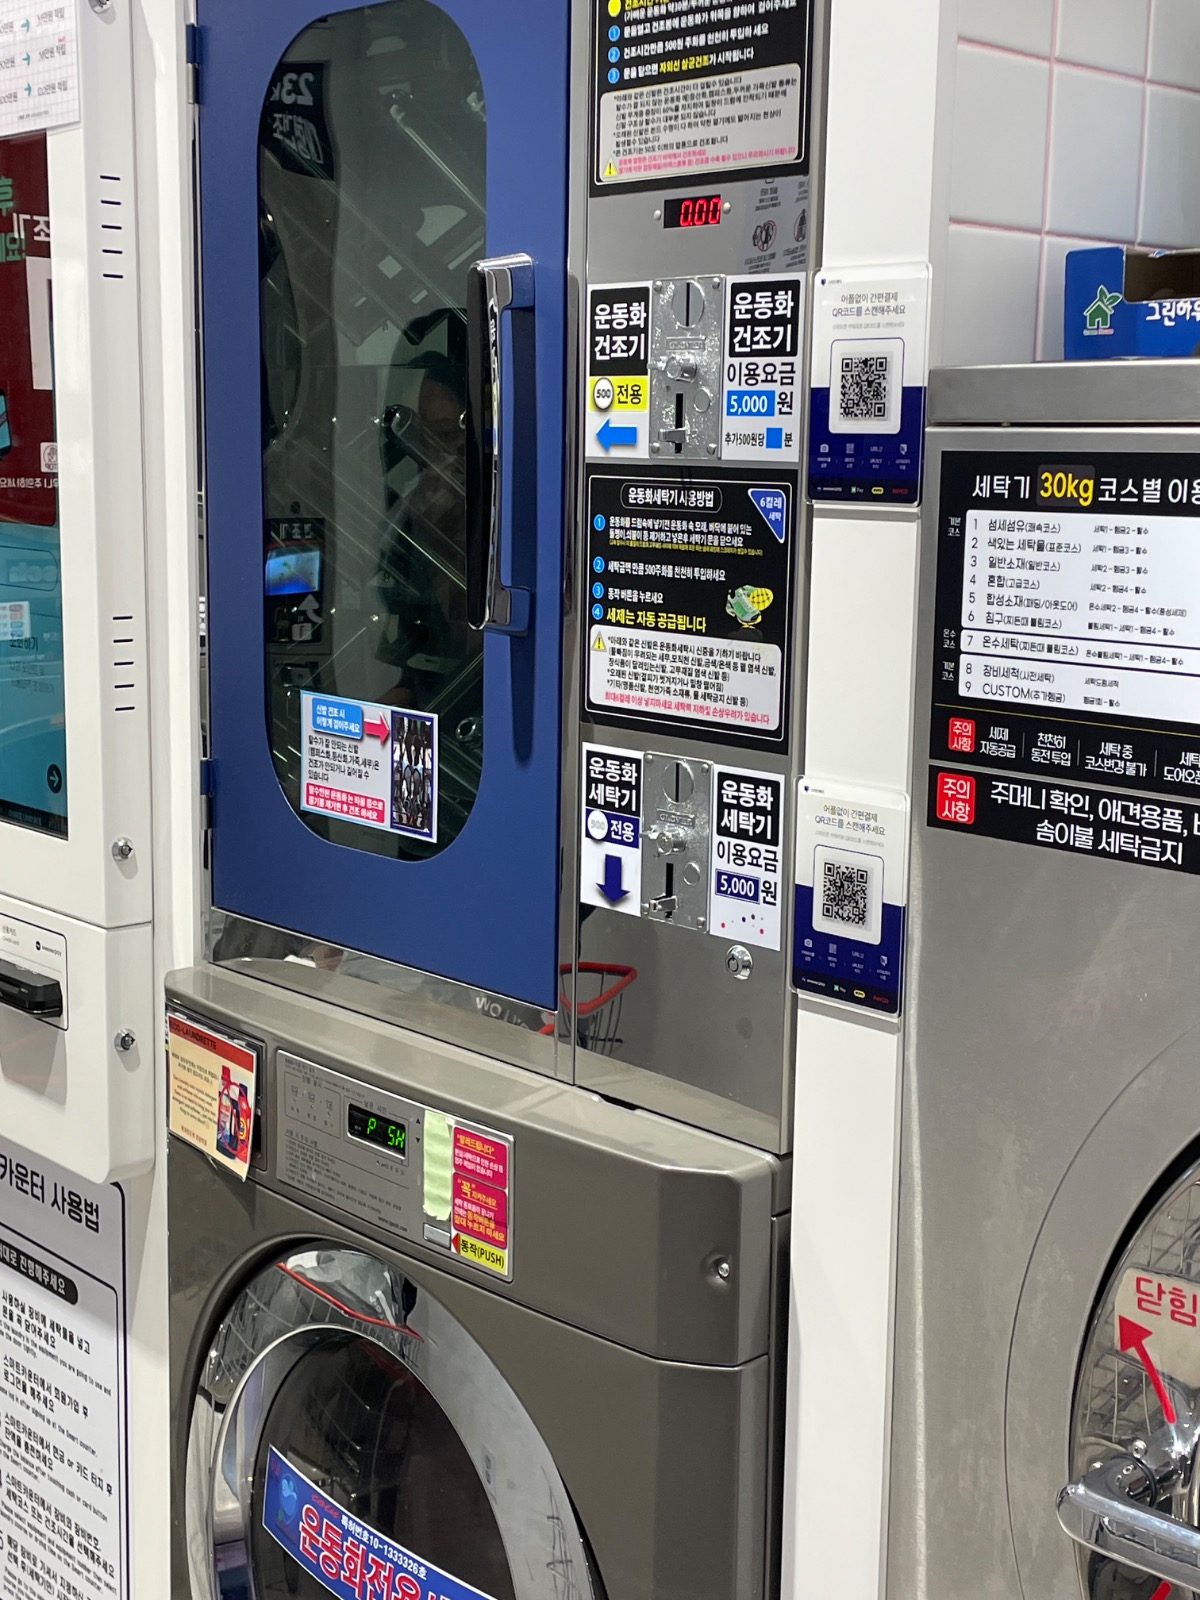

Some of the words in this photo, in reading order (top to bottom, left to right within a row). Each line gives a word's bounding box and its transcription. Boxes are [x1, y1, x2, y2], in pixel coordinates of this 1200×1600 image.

[680, 197, 722, 226] 0.00
[734, 290, 794, 319] 운동화
[594, 302, 646, 330] 운동화
[594, 334, 645, 360] 건조기
[733, 324, 792, 352] 건조기
[727, 362, 796, 386] 이용요금
[596, 388, 611, 399] 500
[617, 384, 642, 405] 전용
[730, 396, 768, 415] 5,000
[777, 391, 794, 415] 원
[725, 432, 765, 447] 추가500원당
[784, 432, 793, 447] 분
[628, 488, 678, 506] 운동화세탁기
[679, 489, 714, 508] 사용방법
[972, 474, 1030, 499] 세탁기
[1040, 472, 1094, 506] 30kg
[1098, 478, 1161, 504] 코스별
[973, 519, 978, 530] 1
[972, 537, 978, 549] 2
[988, 538, 1014, 551] 색있는
[970, 556, 977, 567] 3
[988, 556, 1061, 572] 일반소재(일반코스)
[970, 574, 976, 585] 4
[987, 575, 1040, 590] 혼합(고급코스)
[608, 588, 620, 600] 동작
[639, 591, 663, 604] 누르세요
[969, 592, 975, 603] 5
[607, 608, 635, 625] 세제는
[637, 610, 656, 627] 자동
[657, 612, 706, 633] 공급됩니다
[968, 611, 974, 621] 6
[968, 635, 973, 646] 7
[966, 663, 972, 674] 8
[965, 681, 972, 692] 9
[953, 721, 972, 736] 주의
[989, 726, 1008, 741] 세제
[952, 737, 972, 752] 사항
[980, 741, 1016, 759] 자동공급
[1037, 732, 1066, 749] 천천히
[1099, 741, 1121, 756] 세탁
[1122, 744, 1133, 759] 중
[1031, 748, 1051, 764] 동전
[1051, 752, 1071, 767] 투입
[1084, 756, 1125, 774] 코스변경
[1126, 762, 1147, 777] 불가
[589, 757, 637, 785] 운동화
[589, 783, 636, 812] 세탁기
[721, 780, 773, 811] 운동화
[943, 778, 970, 799] 주의
[942, 802, 970, 822] 사항
[990, 781, 1045, 810] 주머니
[1050, 790, 1093, 821] 확인,
[1099, 798, 1187, 837] 애견용품,
[610, 820, 634, 843] 전용
[721, 808, 772, 840] 세탁기
[1036, 819, 1094, 850] 솜이불
[1097, 829, 1182, 865] 세탁금지
[717, 841, 778, 873] 이용요금
[720, 876, 755, 897] 5,000
[761, 880, 777, 906] 원
[367, 1118, 376, 1134] P
[51, 1182, 99, 1234] 사용법
[461, 1240, 504, 1268] 동작(PUSH)
[20, 1254, 66, 1295] 진행해주세요
